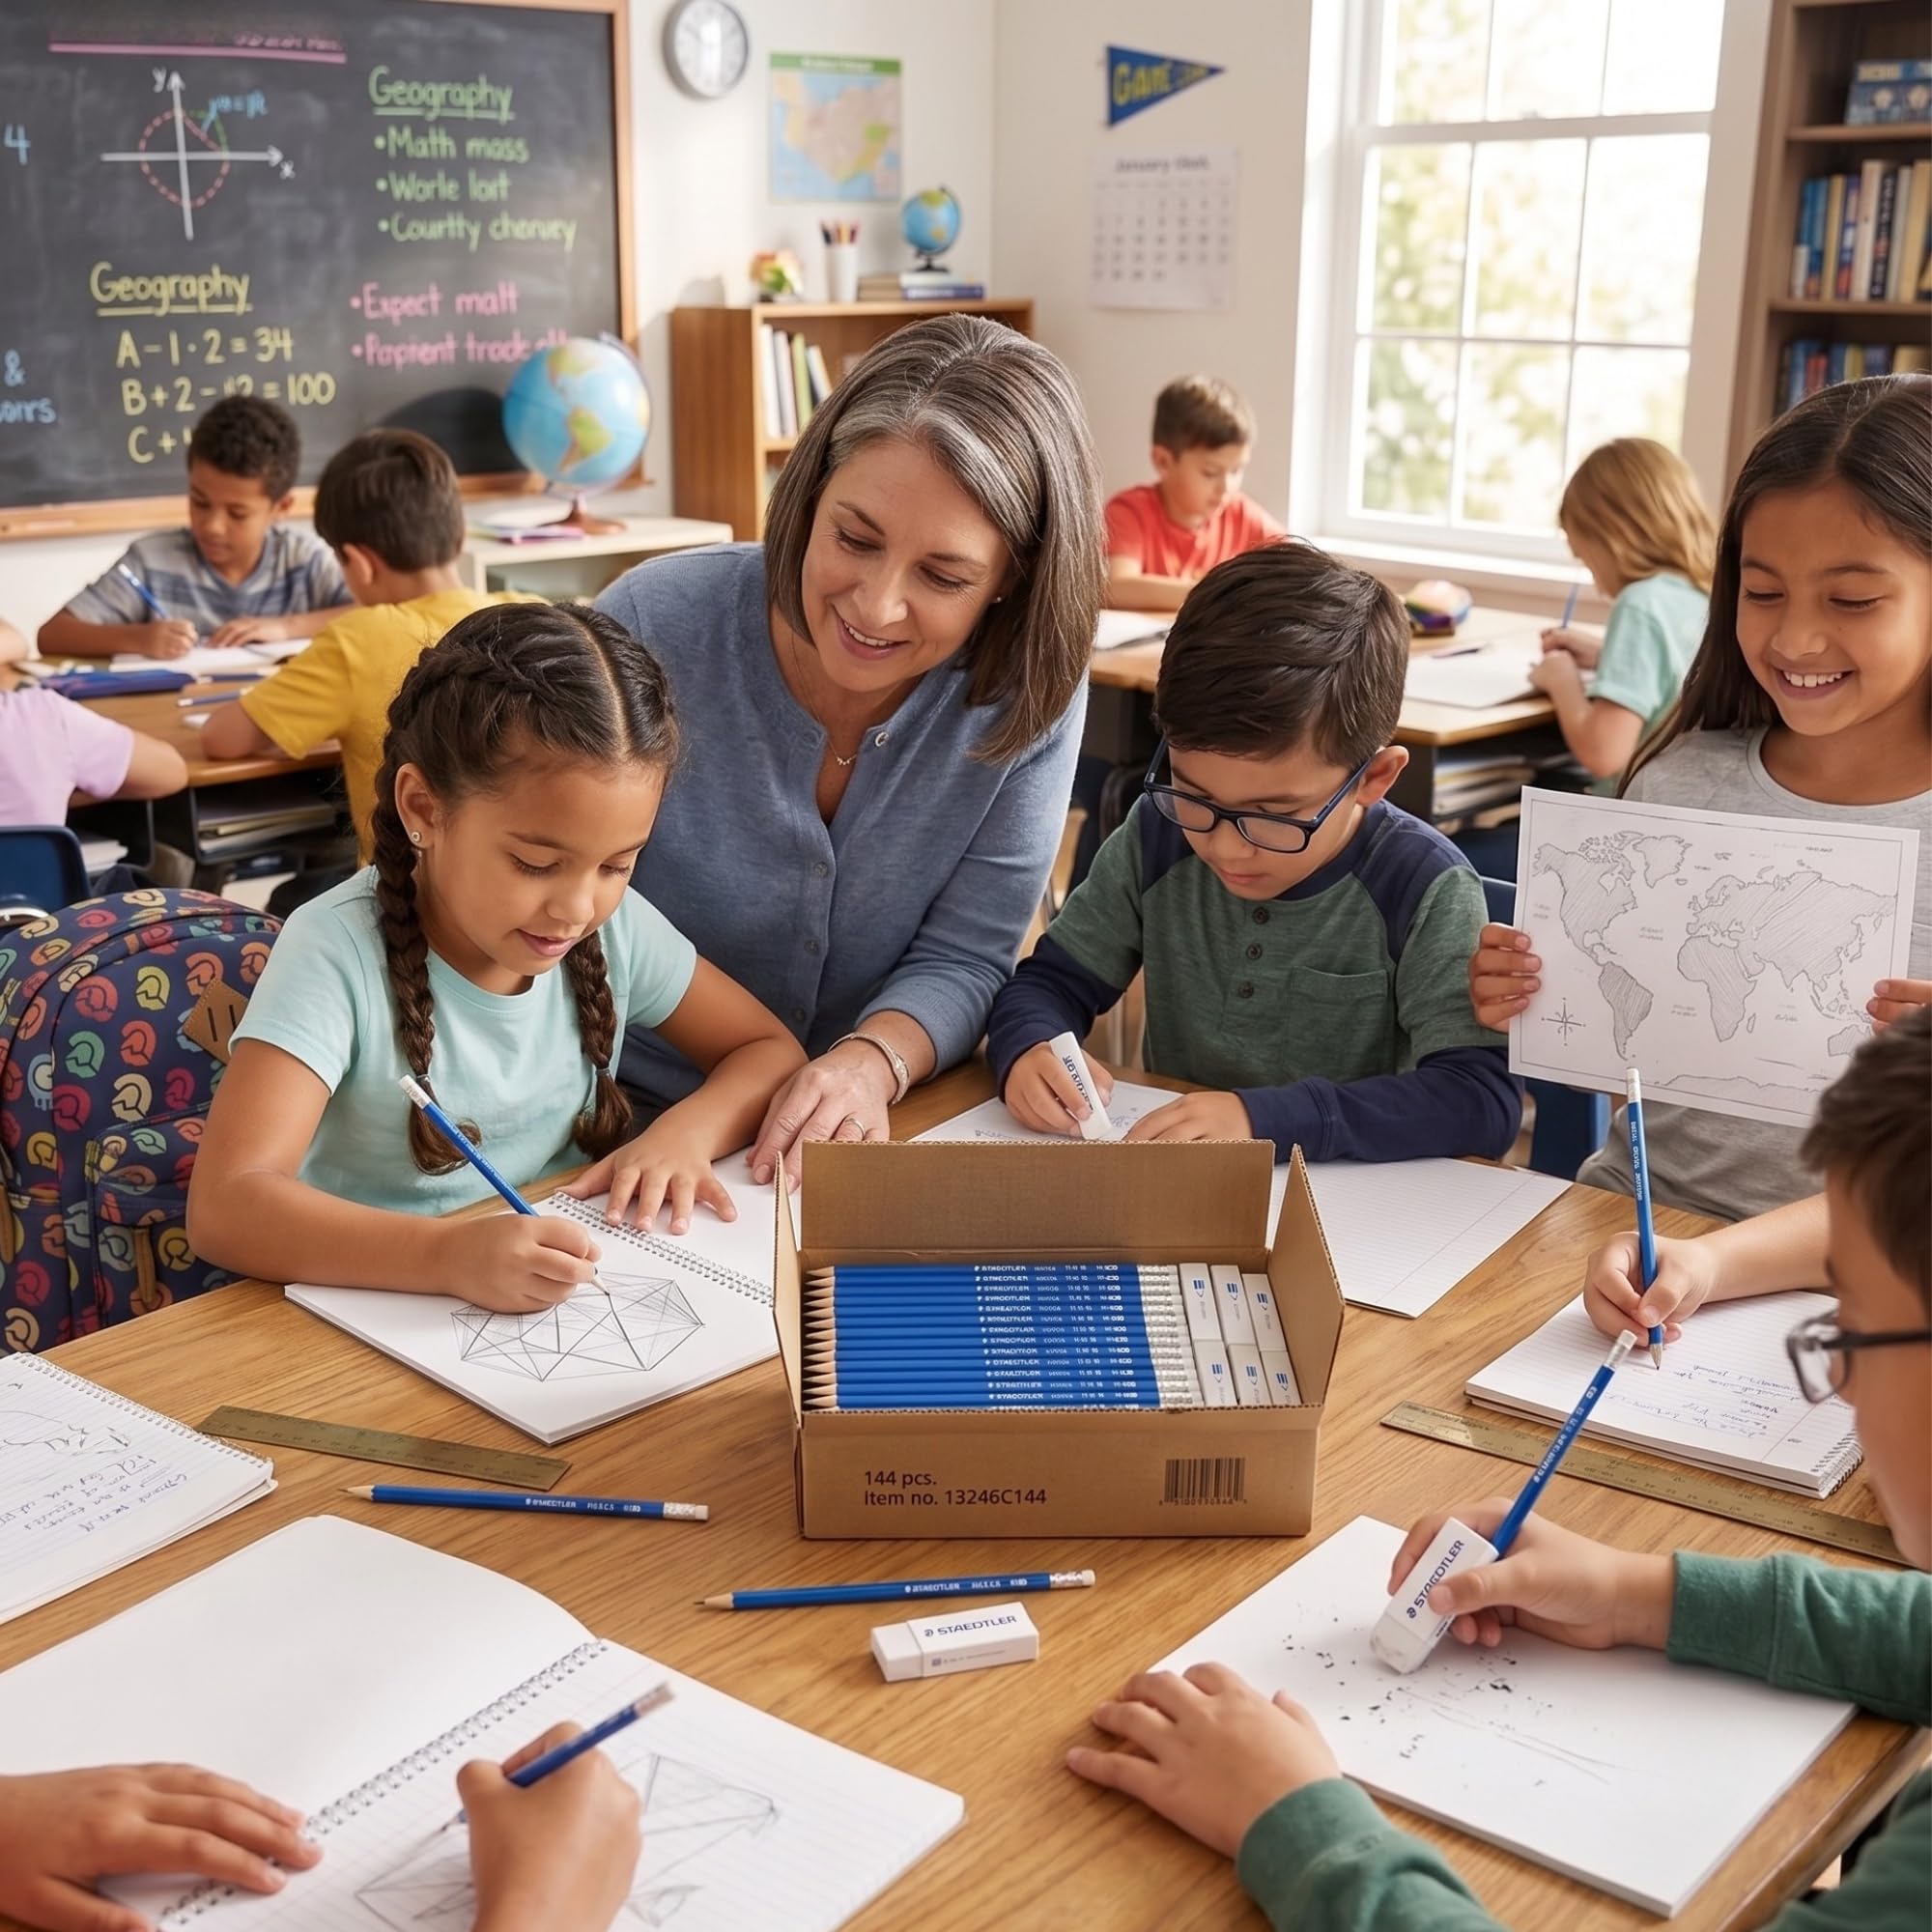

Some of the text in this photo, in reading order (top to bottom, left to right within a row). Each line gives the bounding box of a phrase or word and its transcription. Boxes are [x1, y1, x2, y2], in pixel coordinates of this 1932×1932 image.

[368, 65, 514, 125] Geography
[4, 124, 31, 166] 4
[90, 261, 250, 317] Geography
[287, 371, 336, 406] 100
[865, 1470, 937, 1489] 144 pcs.
[865, 1489, 1047, 1506] Item no. 13246C144
[937, 1614, 1018, 1636] STAEDTLER
